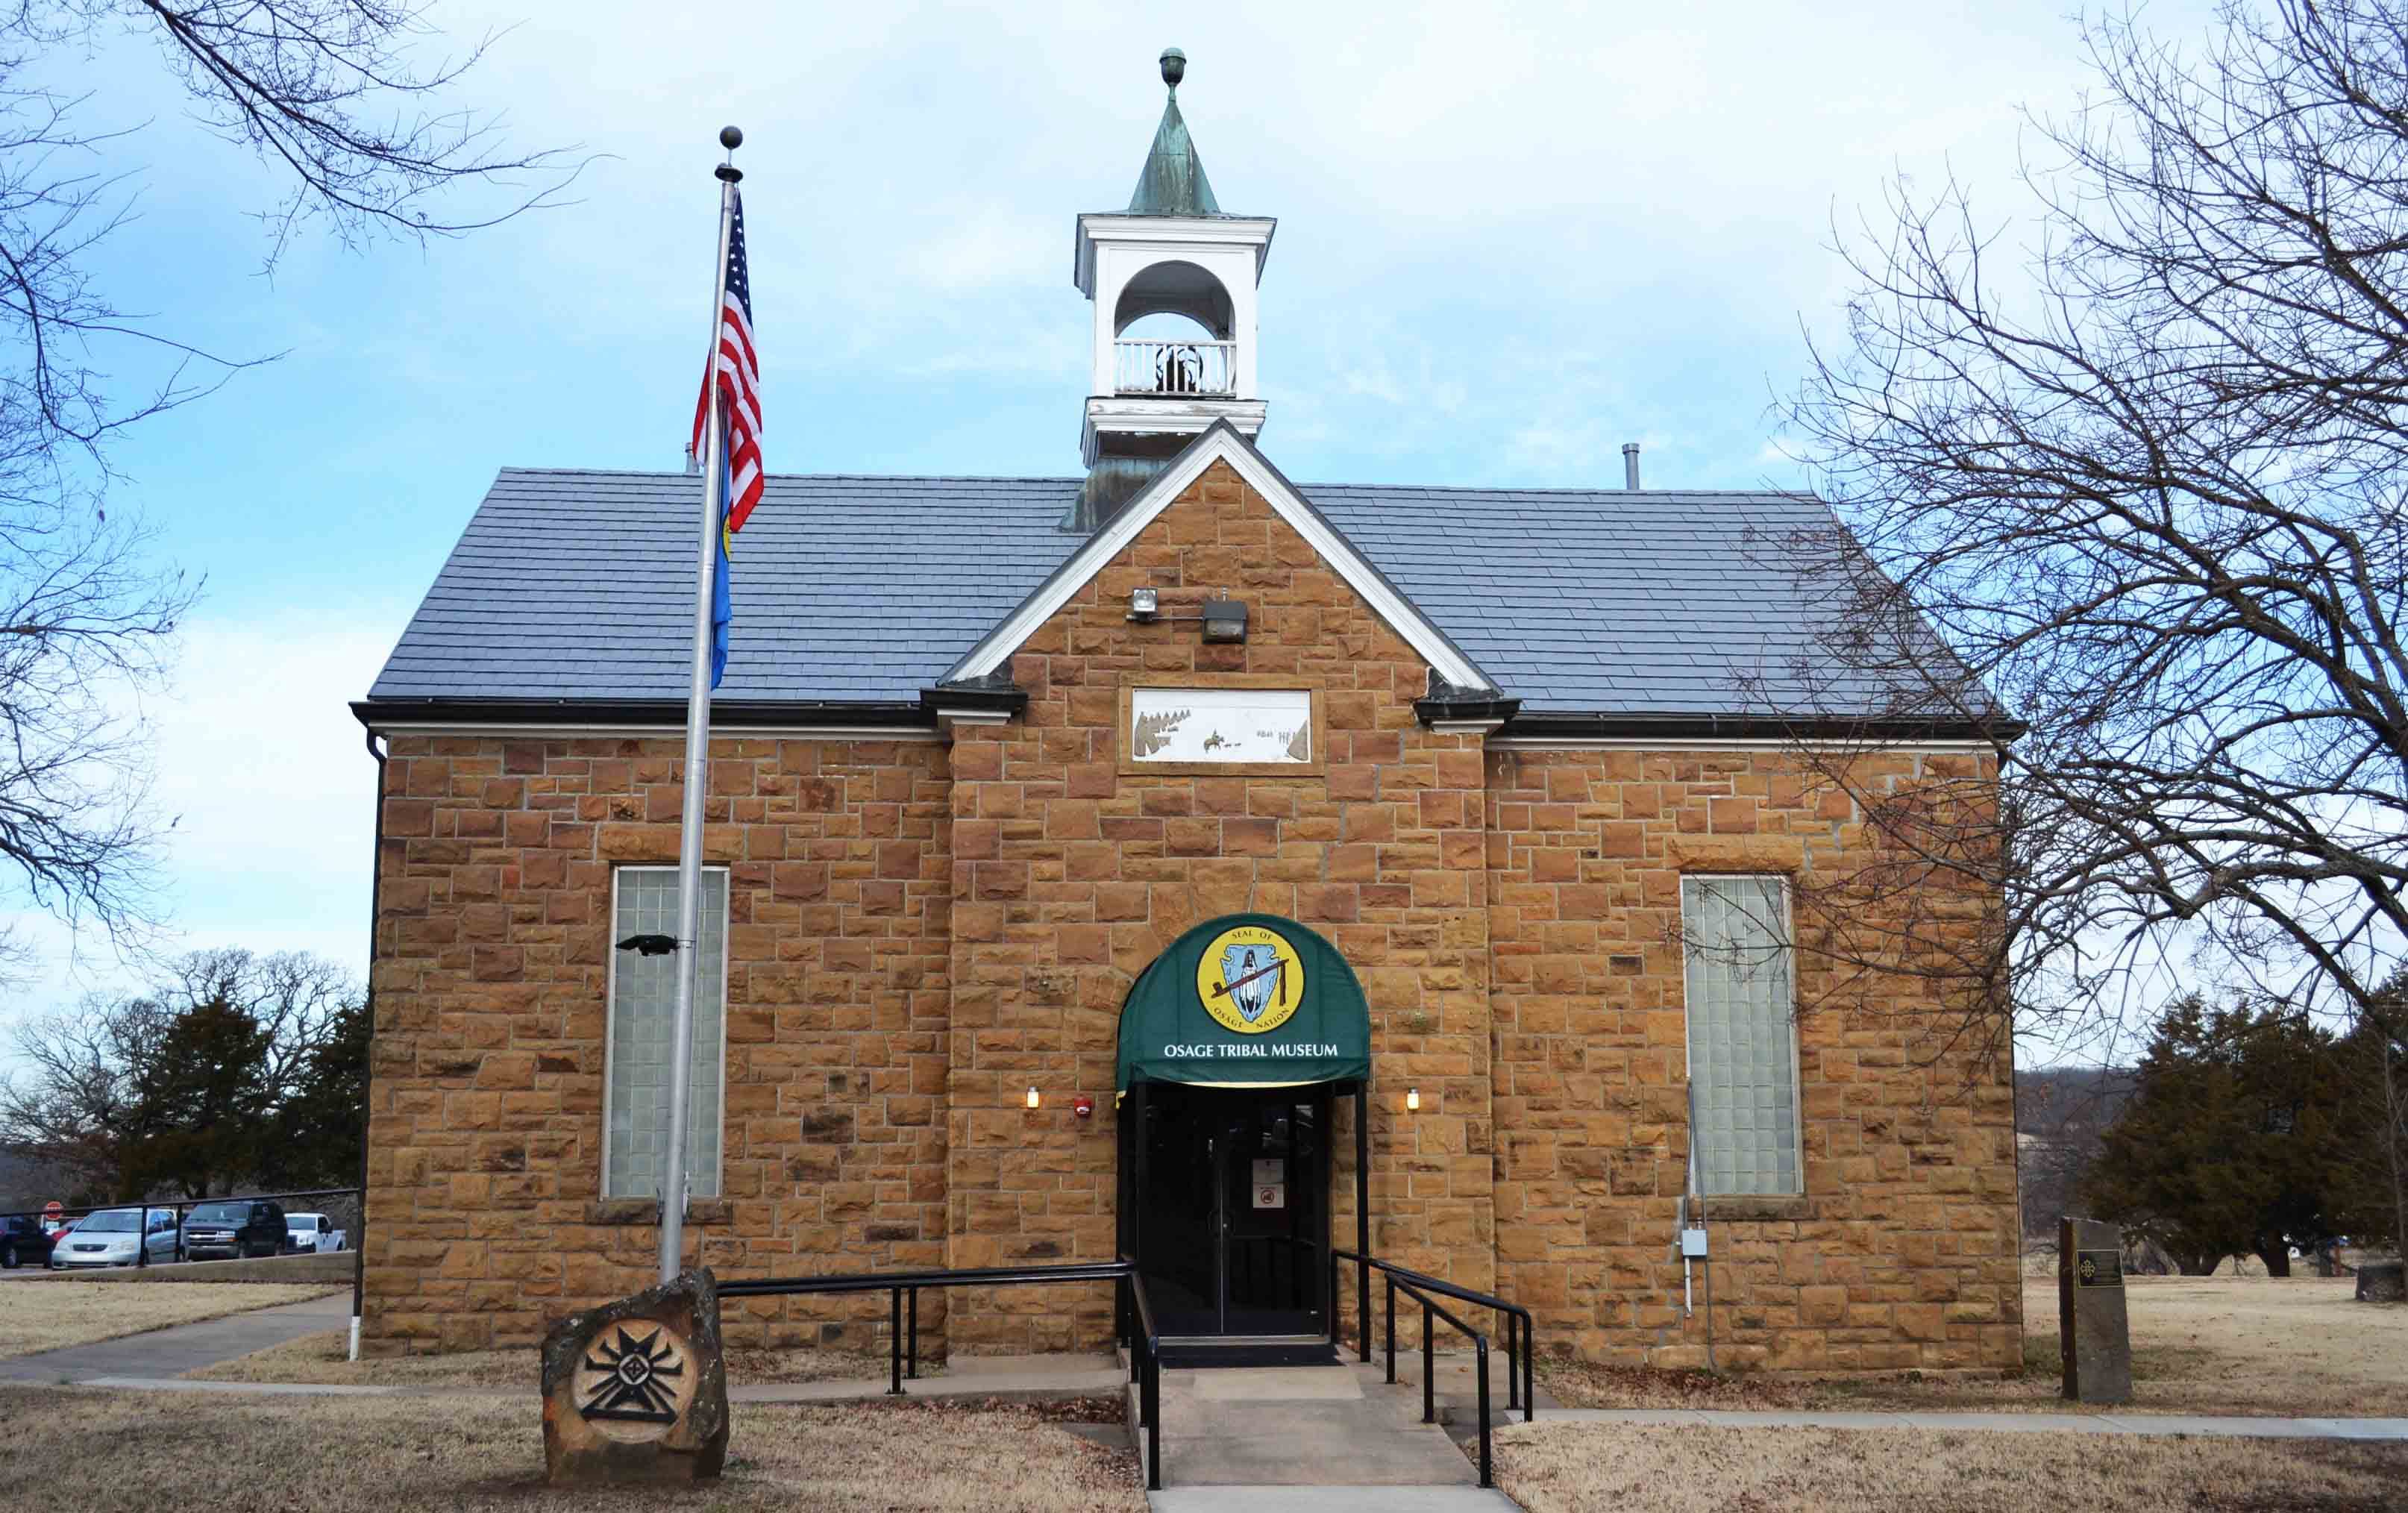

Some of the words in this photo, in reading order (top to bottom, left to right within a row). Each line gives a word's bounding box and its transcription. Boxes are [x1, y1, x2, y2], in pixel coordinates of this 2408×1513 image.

[1232, 930, 1254, 939] SEAL
[1259, 931, 1273, 941] OF
[1214, 1007, 1243, 1028] OSAGE
[1255, 1008, 1290, 1029] NATION
[1164, 1044, 1214, 1057] OSAGE
[1217, 1044, 1267, 1057] TRIBAL
[1271, 1044, 1338, 1057] MUSEUM
